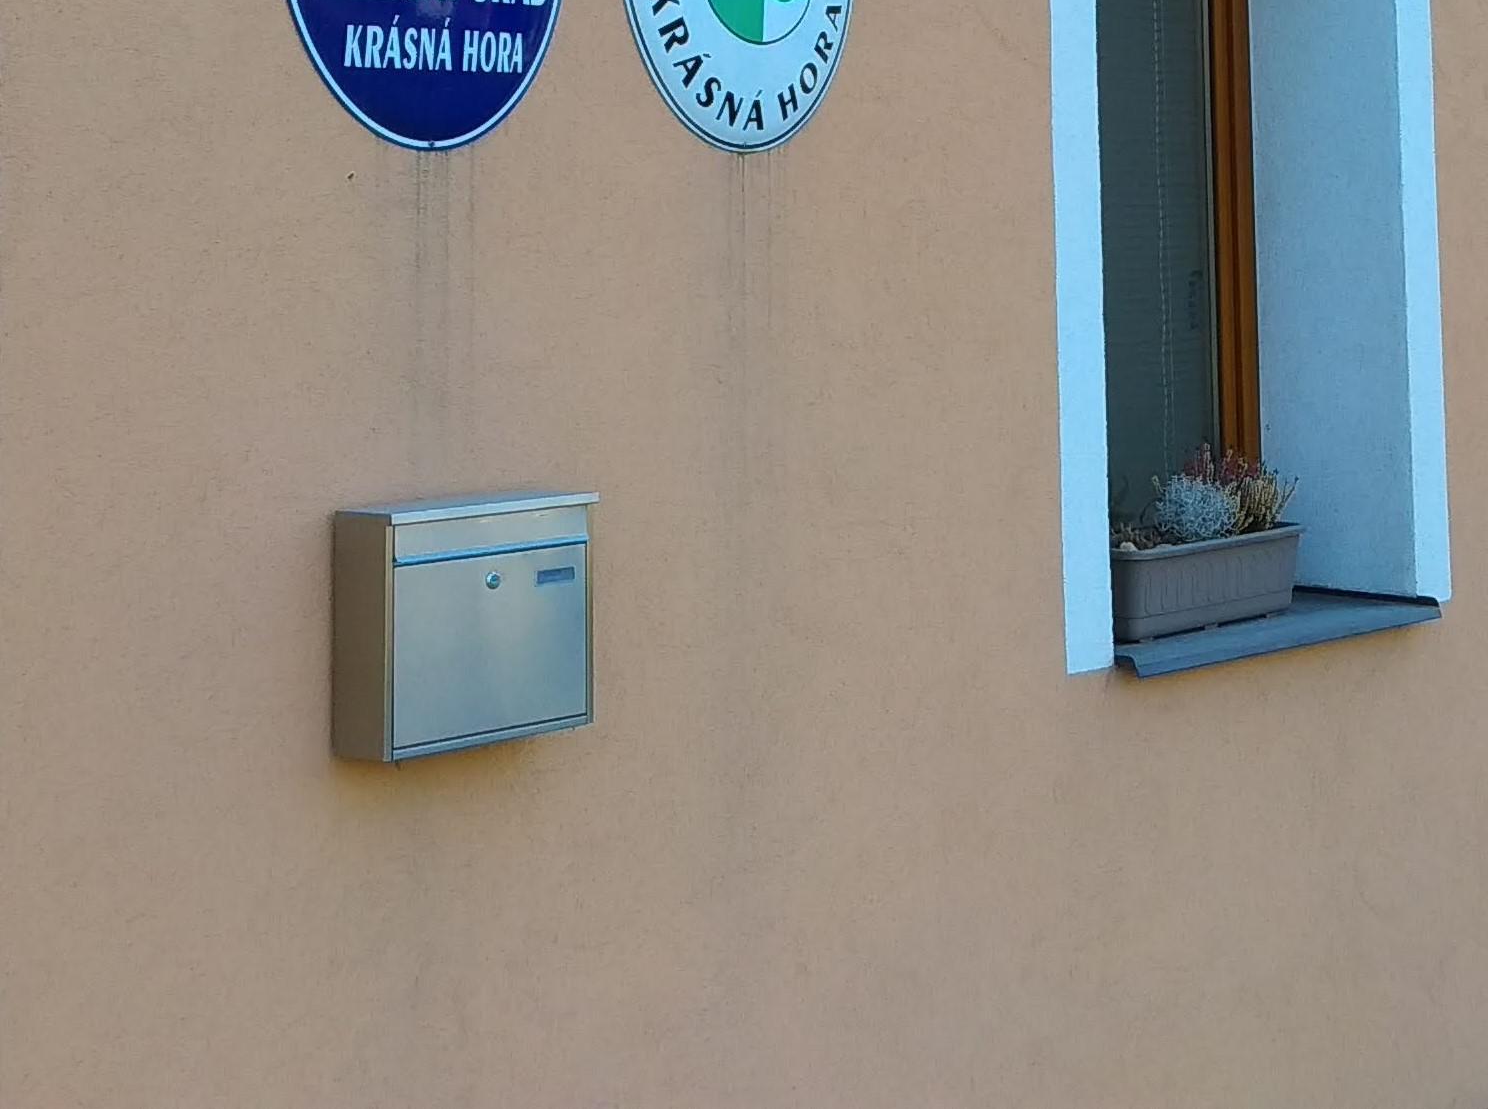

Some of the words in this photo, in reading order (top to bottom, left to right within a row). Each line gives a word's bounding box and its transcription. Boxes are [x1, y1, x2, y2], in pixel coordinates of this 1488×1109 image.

[343, 14, 452, 71] KRÁSNÁ
[462, 29, 523, 74] HORA
[777, 4, 843, 122] HORA
